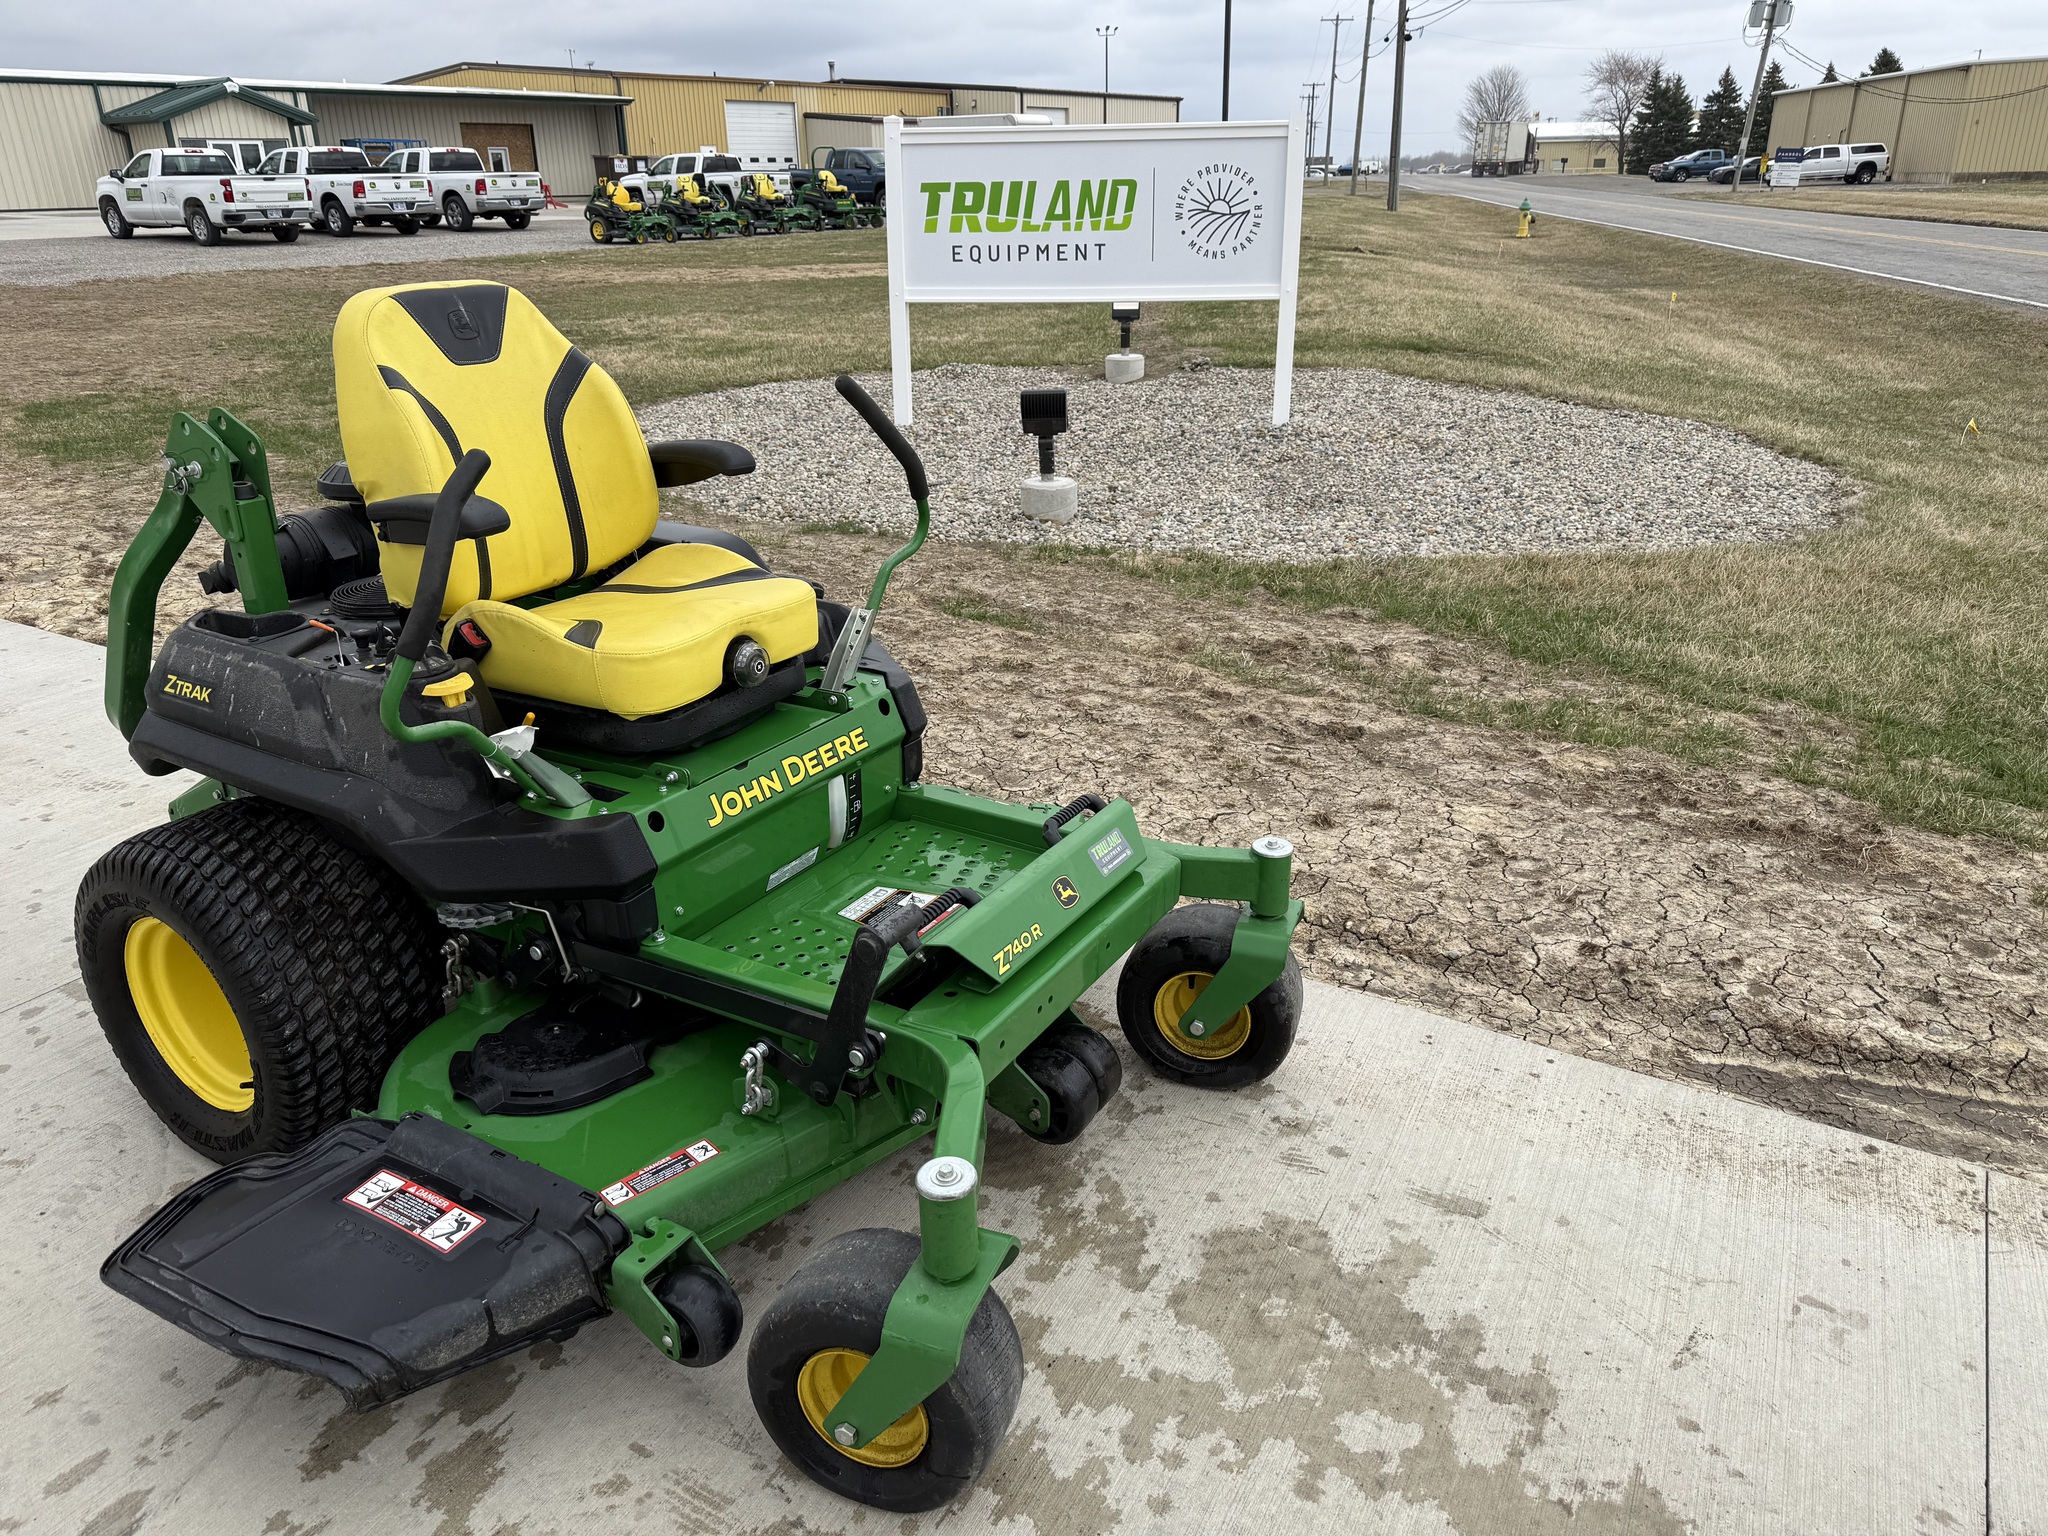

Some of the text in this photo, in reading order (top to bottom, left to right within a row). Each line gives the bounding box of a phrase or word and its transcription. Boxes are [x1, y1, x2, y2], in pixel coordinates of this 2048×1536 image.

[919, 178, 1138, 233] TRULAND
[1174, 163, 1255, 221] WHERE PROVIDER
[951, 243, 1107, 264] EQUIPMENT
[1187, 204, 1263, 260] MEANS PARTNER
[163, 674, 213, 703] ZTRAK
[707, 726, 870, 829] JOHN DEERE
[1090, 831, 1122, 860] TRULAND
[82, 891, 151, 964] CARLISLE
[992, 922, 1045, 976] Z740 R
[169, 1111, 256, 1153] MASTER
[643, 1156, 672, 1172] DANGER
[415, 1188, 450, 1209] DANGER
[335, 1218, 357, 1232] DO
[356, 1227, 383, 1245] NOT
[381, 1239, 431, 1273] REMOVE
